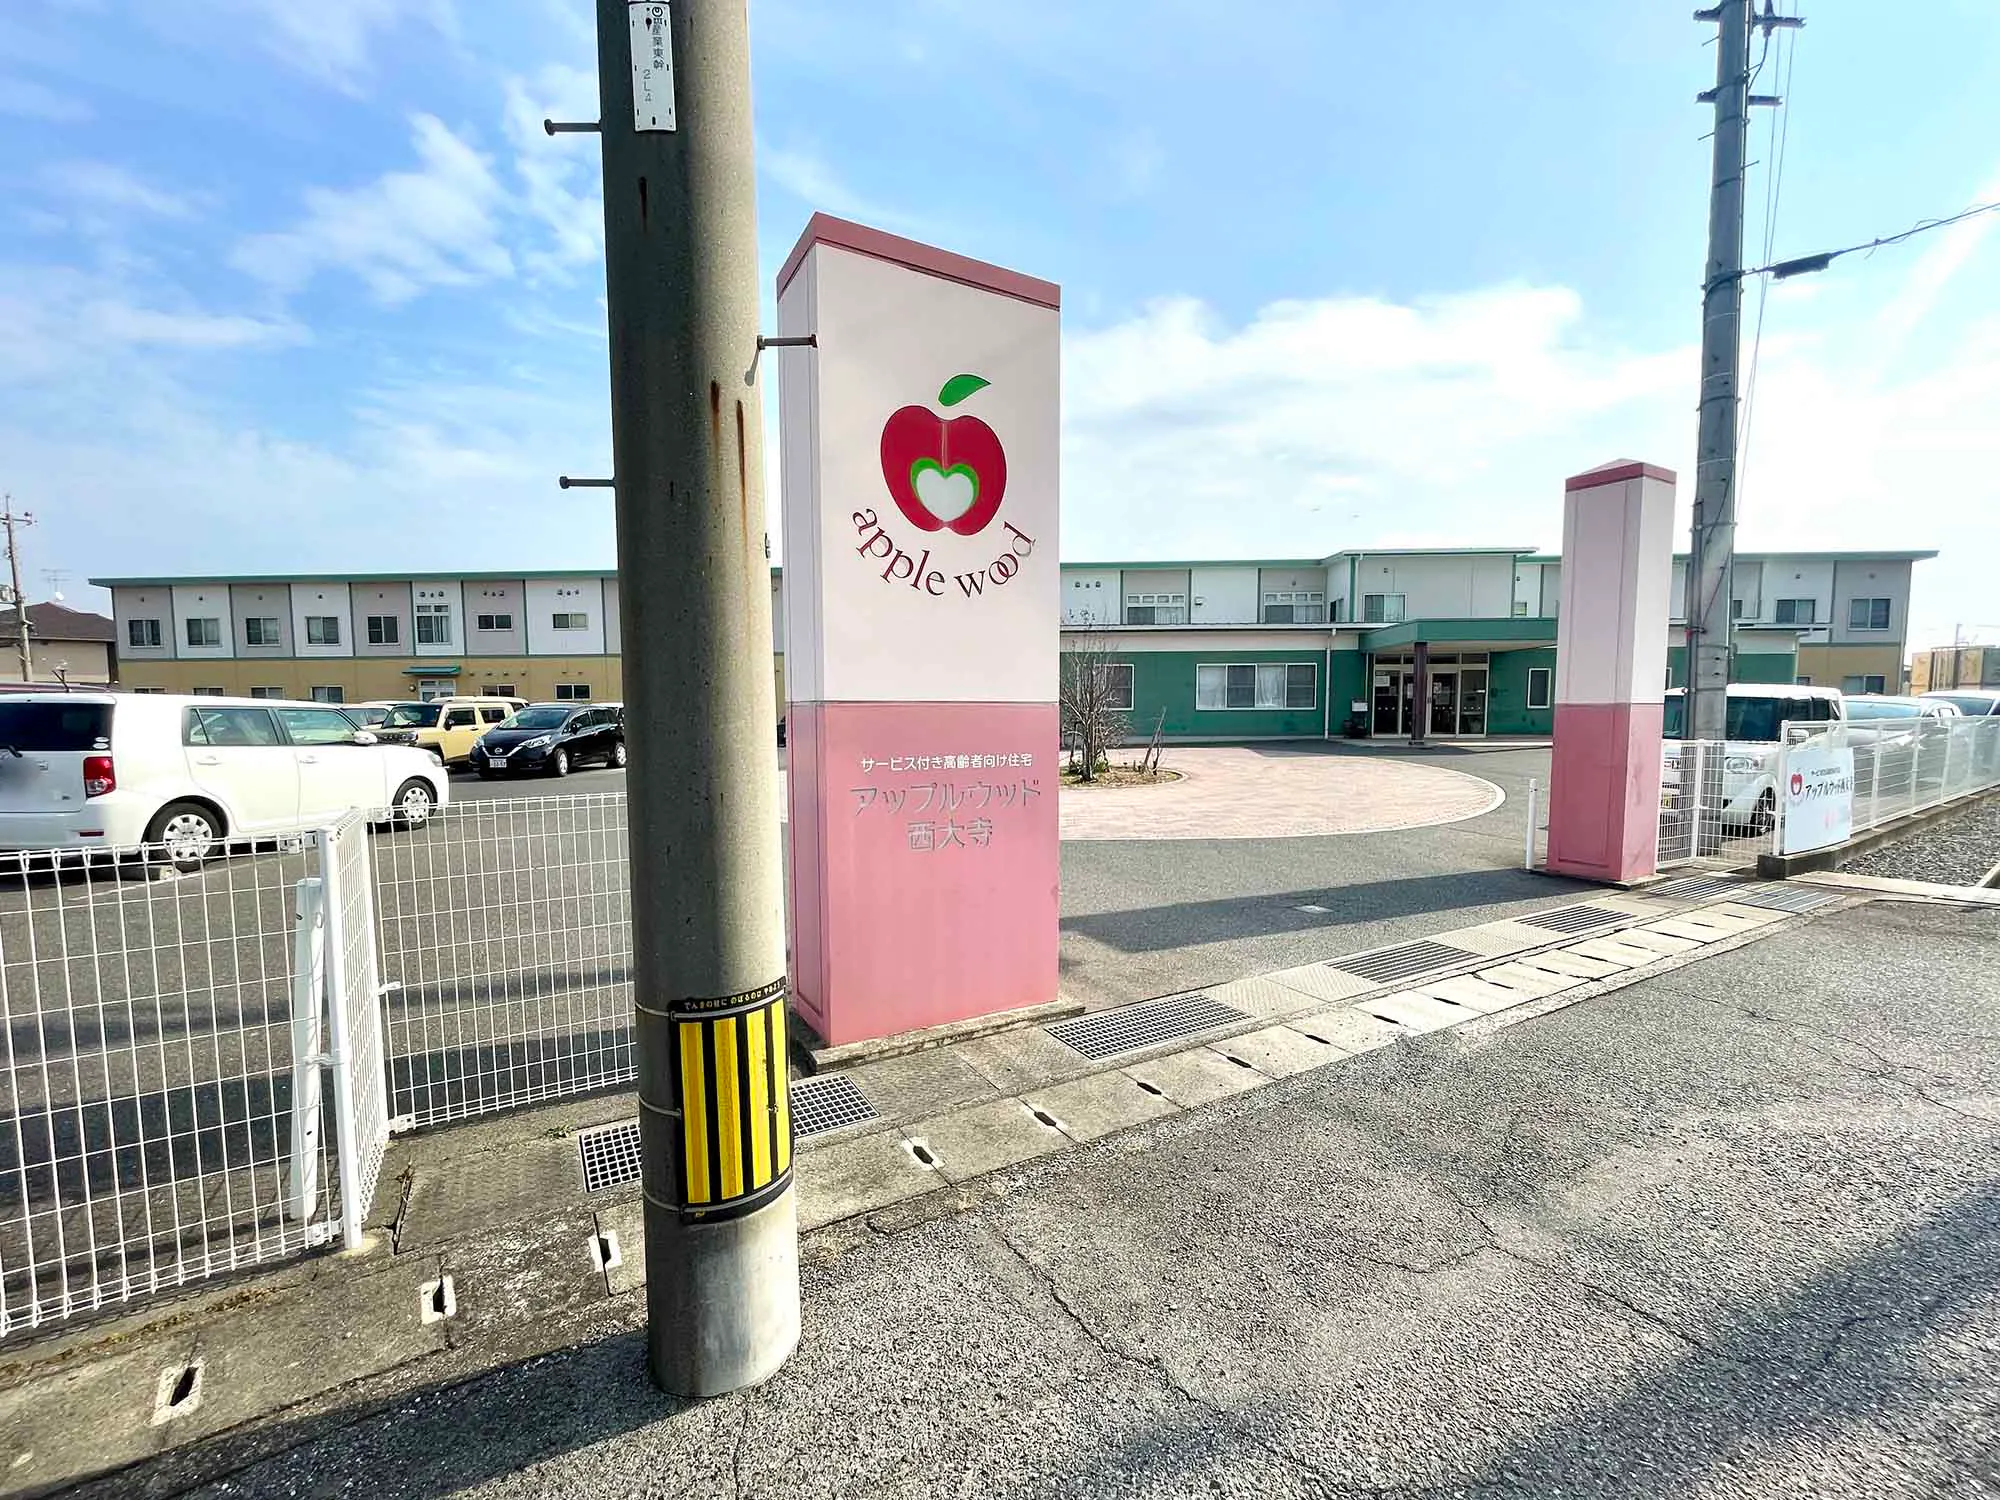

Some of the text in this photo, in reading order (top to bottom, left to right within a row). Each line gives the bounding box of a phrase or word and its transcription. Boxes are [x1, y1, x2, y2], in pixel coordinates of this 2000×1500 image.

[851, 508, 1037, 598] apple wood
[860, 753, 1034, 773] サービス付き高齢者向け住宅
[849, 778, 1042, 817] アップルウッド
[907, 816, 993, 852] 西大寺
